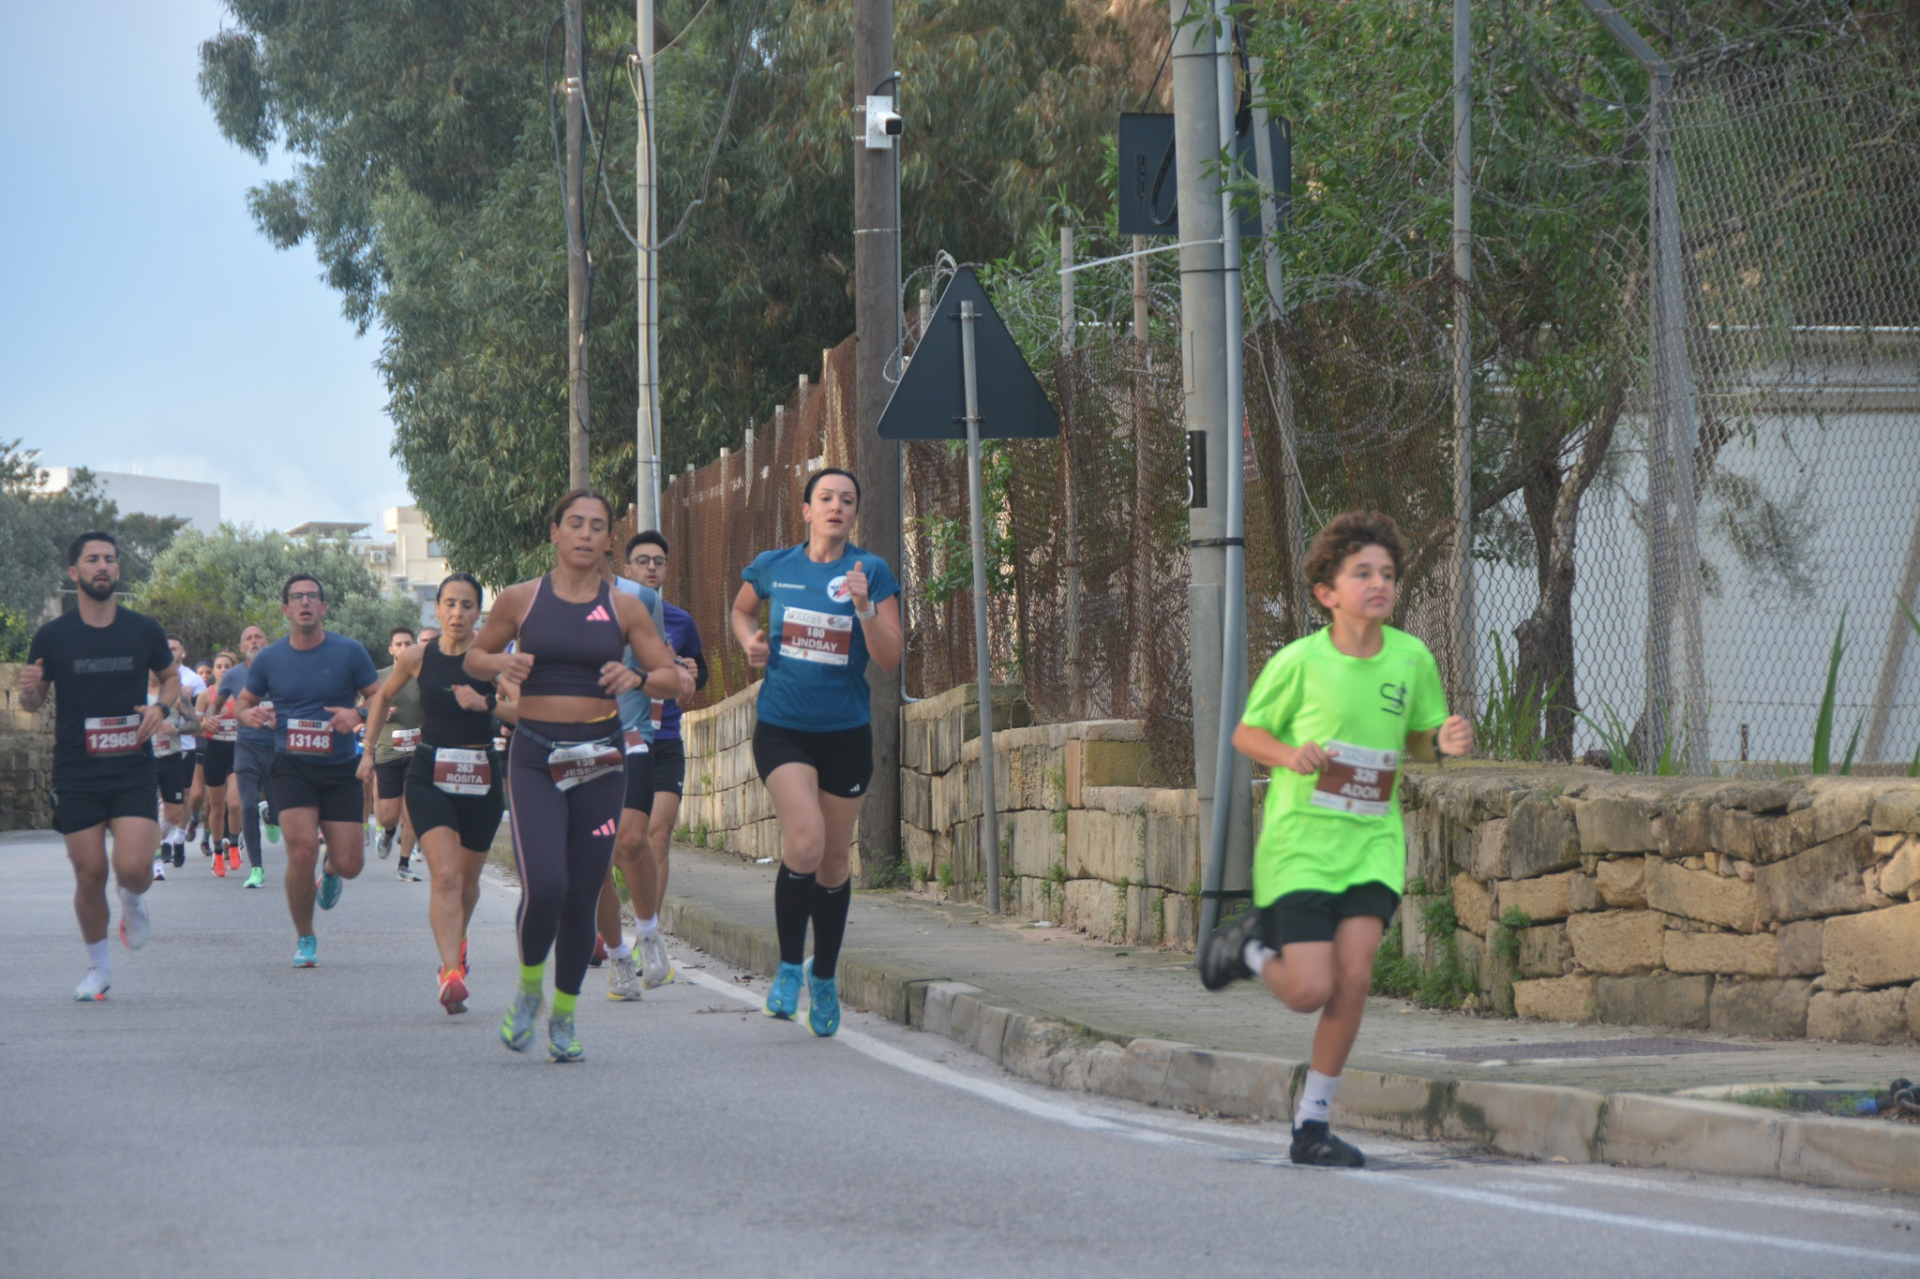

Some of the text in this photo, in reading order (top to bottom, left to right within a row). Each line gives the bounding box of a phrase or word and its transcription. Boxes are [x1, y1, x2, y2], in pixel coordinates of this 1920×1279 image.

[806, 626, 825, 638] 180
[791, 636, 838, 652] LINDSAY
[89, 731, 137, 749] 12968
[289, 733, 330, 749] 13148
[457, 763, 474, 773] 263
[446, 773, 483, 784] ROSITA
